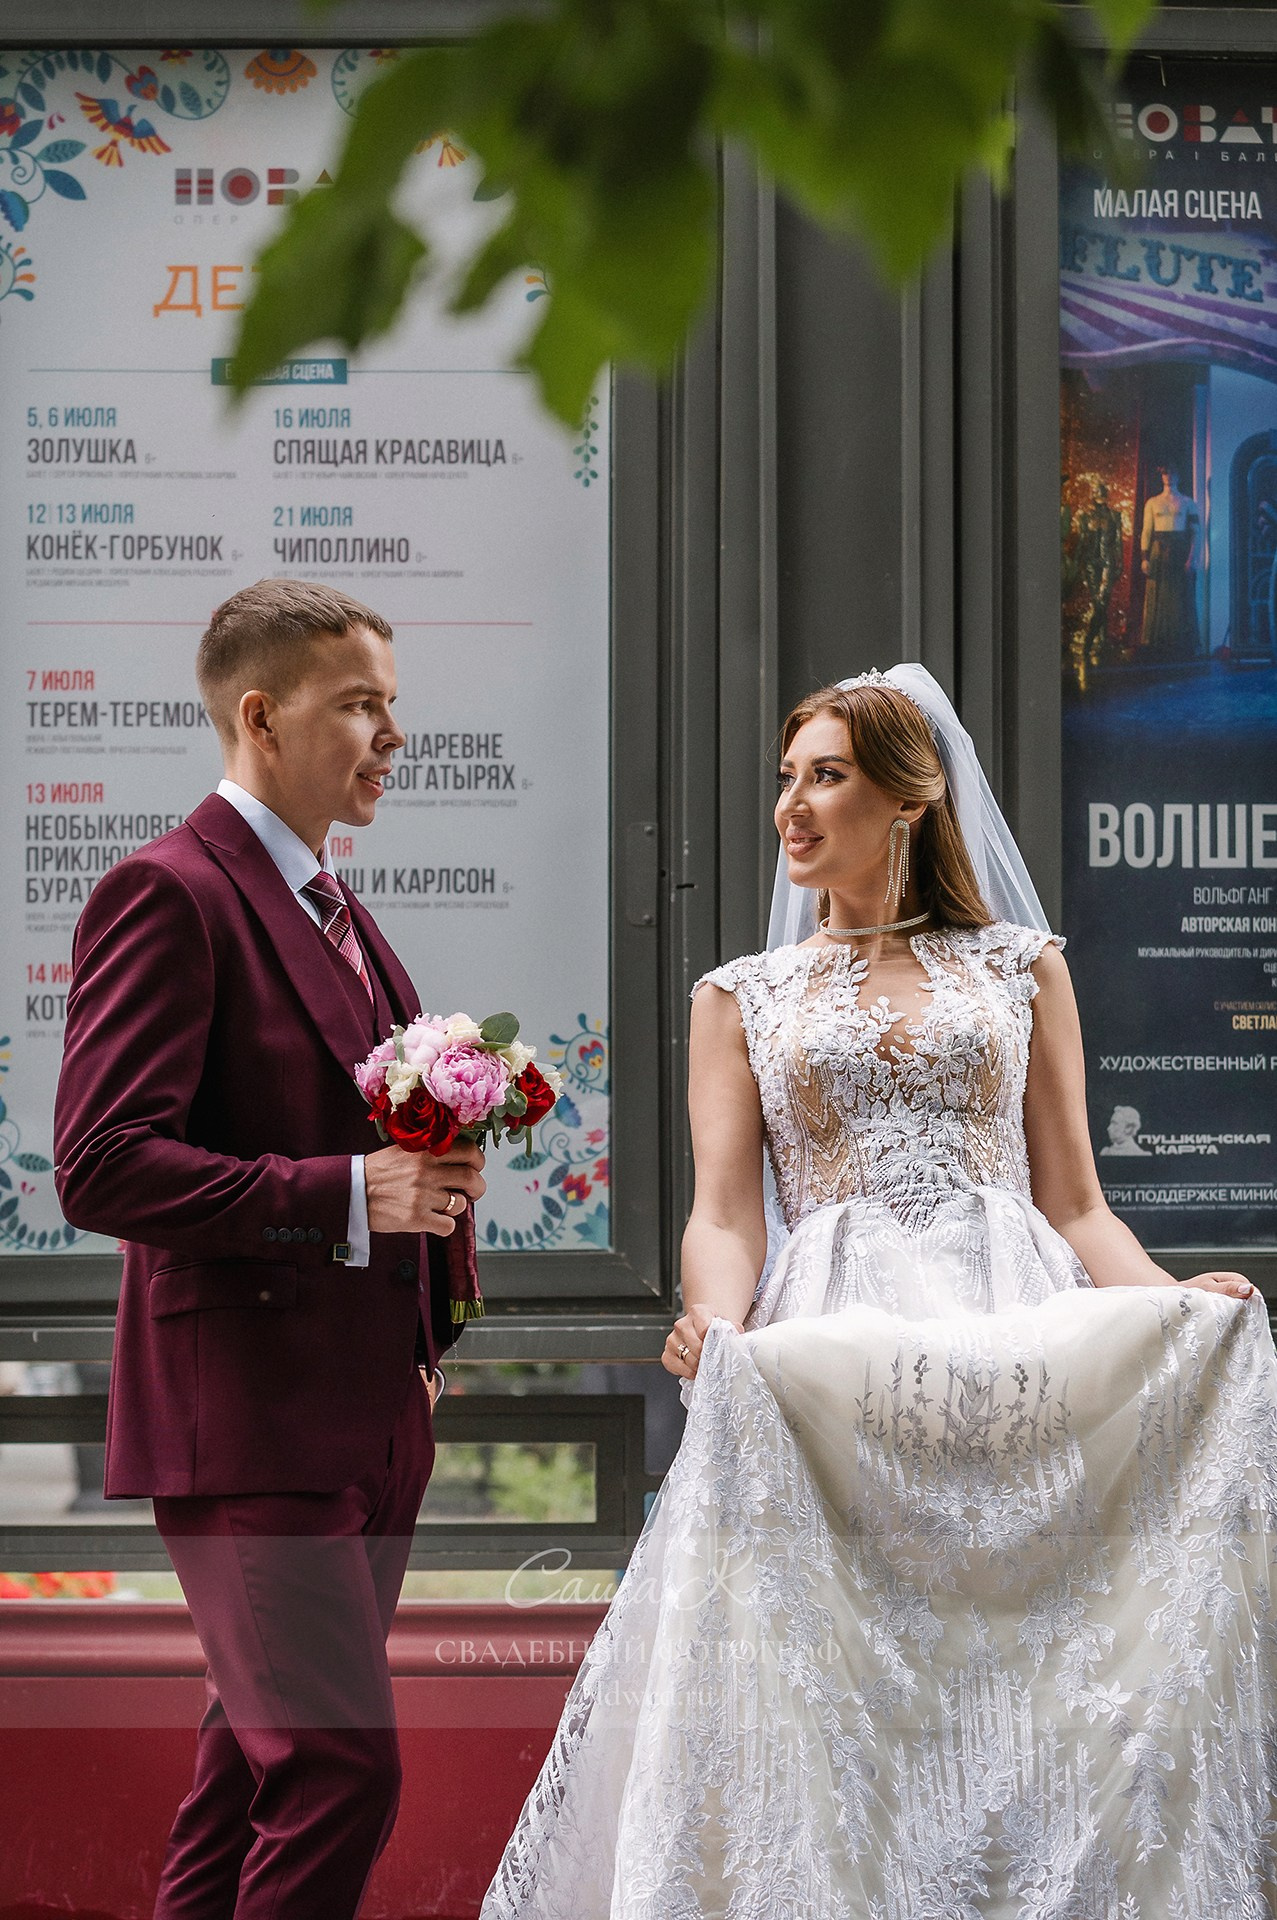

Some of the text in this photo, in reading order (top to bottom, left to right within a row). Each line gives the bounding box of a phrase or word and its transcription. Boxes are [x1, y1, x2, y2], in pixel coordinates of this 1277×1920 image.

[1220, 151, 1277, 162] БАЛ
[1093, 189, 1263, 222] МАЛАЯ СЦЕНА
[1061, 230, 1265, 303] FLUTE
[152, 265, 263, 318] ДЕ
[291, 363, 335, 382] СЦЕНА
[27, 407, 117, 429] 5, 6 ИЮЛЯ
[273, 408, 351, 429] 16 ИЮЛЯ
[27, 438, 138, 464] ЗОЛУШКА
[273, 439, 368, 468] СПЯЩАЯ
[375, 439, 507, 468] КРАСАВИЦА
[57, 504, 76, 524] 13
[81, 504, 135, 524] ИЮЛЯ
[273, 506, 353, 527] 21 ИЮЛЯ
[27, 530, 223, 561] КОНЁК-ГОРБУНОК
[273, 537, 410, 563] ЧИПОЛЛИНО
[27, 670, 95, 691] 7 ИЮЛЯ
[26, 702, 209, 728] ТЕРЕМ-ТЕРЕМОК
[404, 733, 503, 762] ЦАРЕВНЕ
[27, 783, 104, 804] 13 ИЮЛЯ
[1088, 802, 1277, 869] ВОЛШЕ
[26, 878, 98, 903] БУРАТ
[372, 868, 385, 893] И
[393, 868, 495, 894] КАРЛСОН
[1193, 887, 1273, 905] ВОЛЬФГАНГ
[1181, 916, 1277, 933] АВТОРСКАЯ КОН
[1138, 946, 1194, 958] МУЗЫКАЛЬНЫЙ
[1195, 947, 1251, 959] РУКОВОДИТЕЛЬ
[27, 963, 46, 984] 14
[1232, 1014, 1277, 1030] СВЕТЛА
[1099, 1054, 1266, 1072] ХУДОЖЕСТВЕННЫЙ
[1138, 1134, 1271, 1144] ПУШКИНСКАЯ
[1155, 1145, 1218, 1155] КАРТА
[1135, 1189, 1227, 1204] ПОДДЕРЖКЕ
